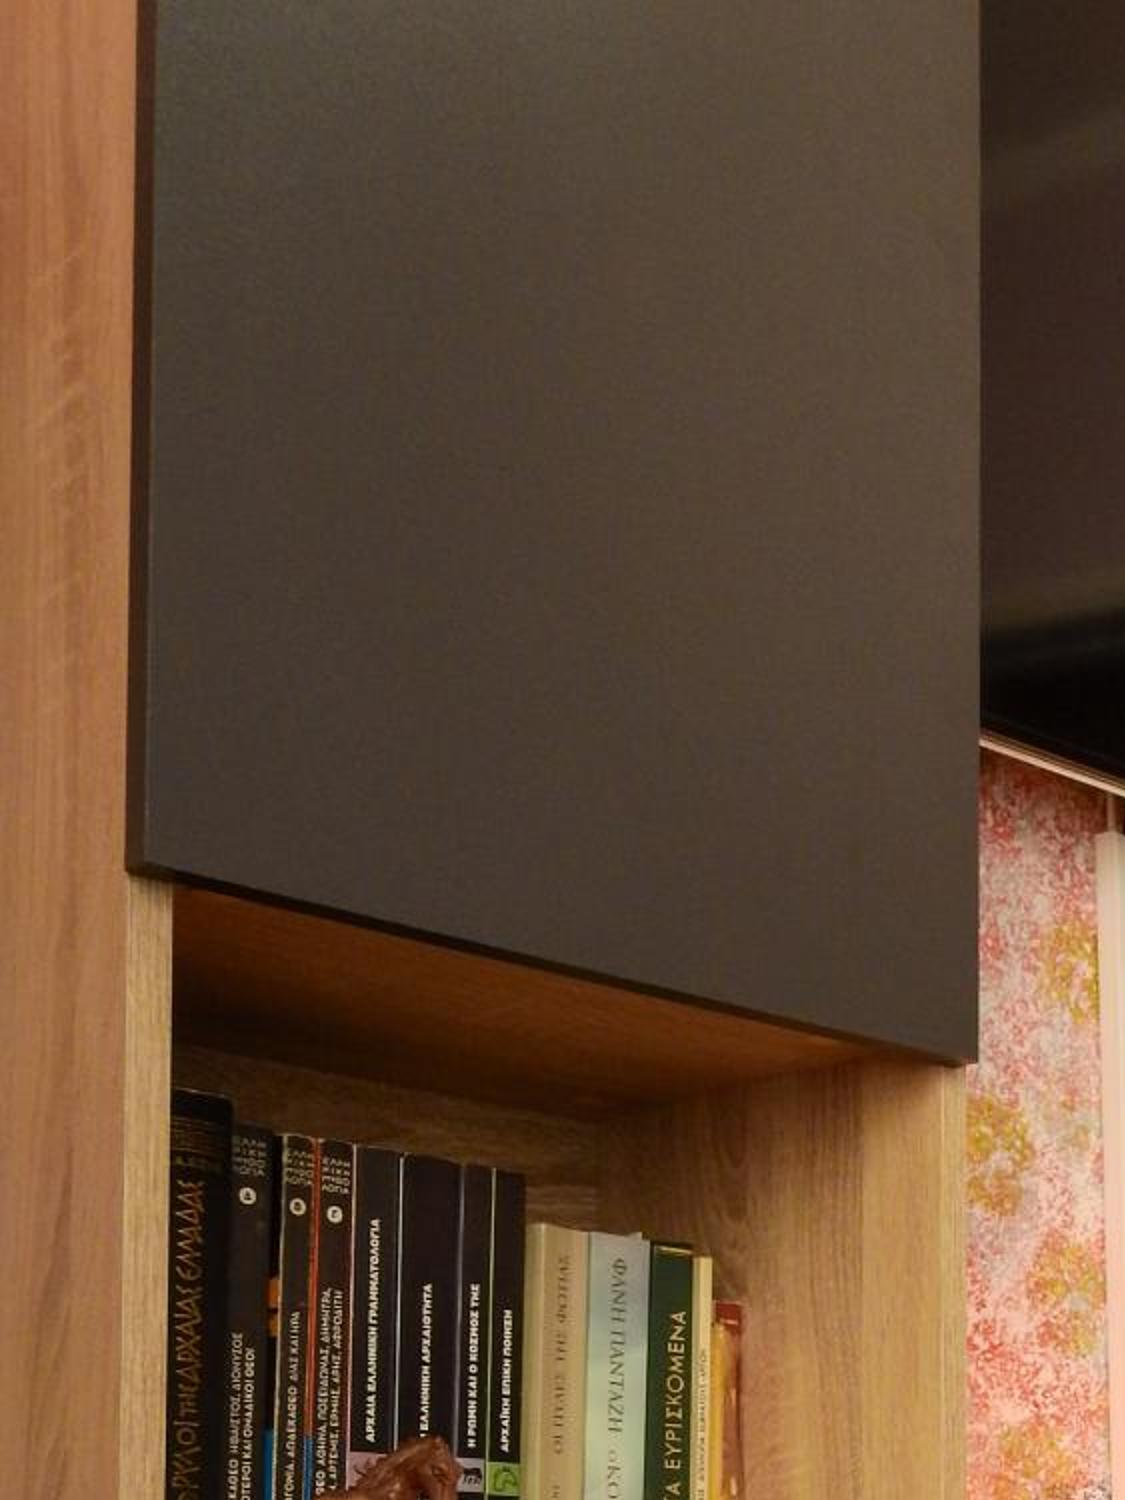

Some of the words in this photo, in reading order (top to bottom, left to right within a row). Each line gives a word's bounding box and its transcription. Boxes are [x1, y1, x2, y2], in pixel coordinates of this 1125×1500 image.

[368, 1218, 382, 1325] ΓΡΑΜΜΑΤΟΛΟΓΙΑ
[470, 1283, 481, 1308] ΤΗΣ
[610, 1257, 629, 1323] ΦΑΝΗ
[420, 1283, 433, 1364] ΑΡΧΑΙΟΤΗΤΑ
[469, 1310, 480, 1361] ΚΟΣΜΟΣ
[502, 1309, 514, 1357] ΠΟΙΗΣΗ
[366, 1326, 379, 1393] ΕΛΛΗΝΙΚΗ
[468, 1376, 479, 1397] ΚΑΙ
[501, 1358, 512, 1396] ΕΠΙΚΗ
[607, 1330, 626, 1433] ΠΑΝΤΑΖΗ
[365, 1394, 377, 1443] ΑΡΧΑΙΑ
[419, 1366, 431, 1431] ΕΛΛΗΝΙΚΗ
[467, 1399, 479, 1437] ΡΩΜΗ
[663, 1310, 687, 1470] ΕΥΡΙΣΚΟΜΕΝΑ
